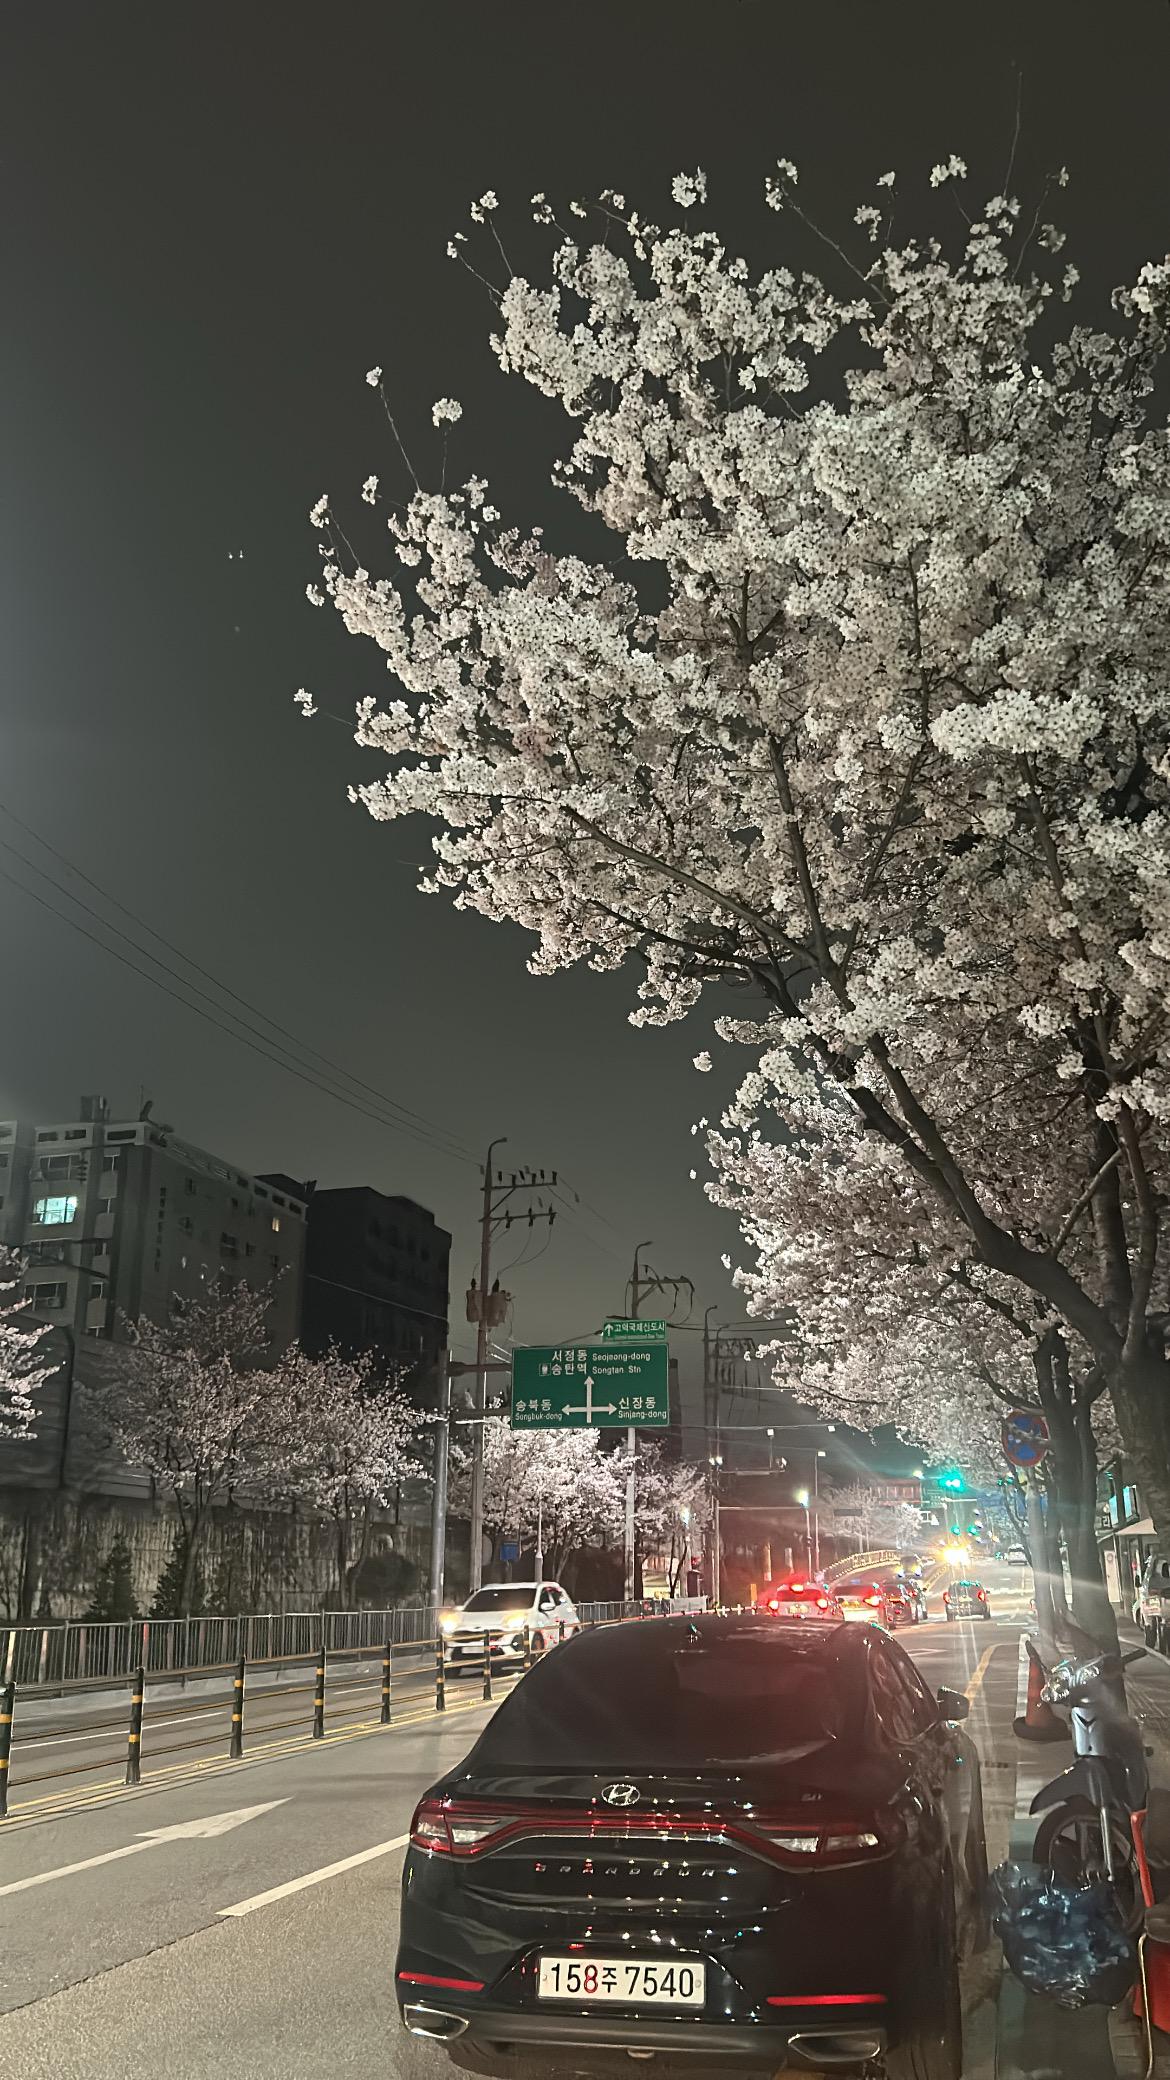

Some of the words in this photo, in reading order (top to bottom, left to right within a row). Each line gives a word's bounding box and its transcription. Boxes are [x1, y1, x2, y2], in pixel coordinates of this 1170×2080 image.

[552, 1350, 588, 1362] 서정동
[592, 1353, 651, 1362] Seojeong-dong
[552, 1363, 587, 1375] 송탄역
[592, 1366, 624, 1375] Songtan
[628, 1365, 641, 1373] Stn
[618, 1396, 656, 1409] 신장동
[515, 1412, 562, 1421] Songbuk-dong
[618, 1410, 667, 1419] Sinjang-dong
[551, 1963, 617, 1994] 158주
[625, 1966, 694, 1998] 7540
